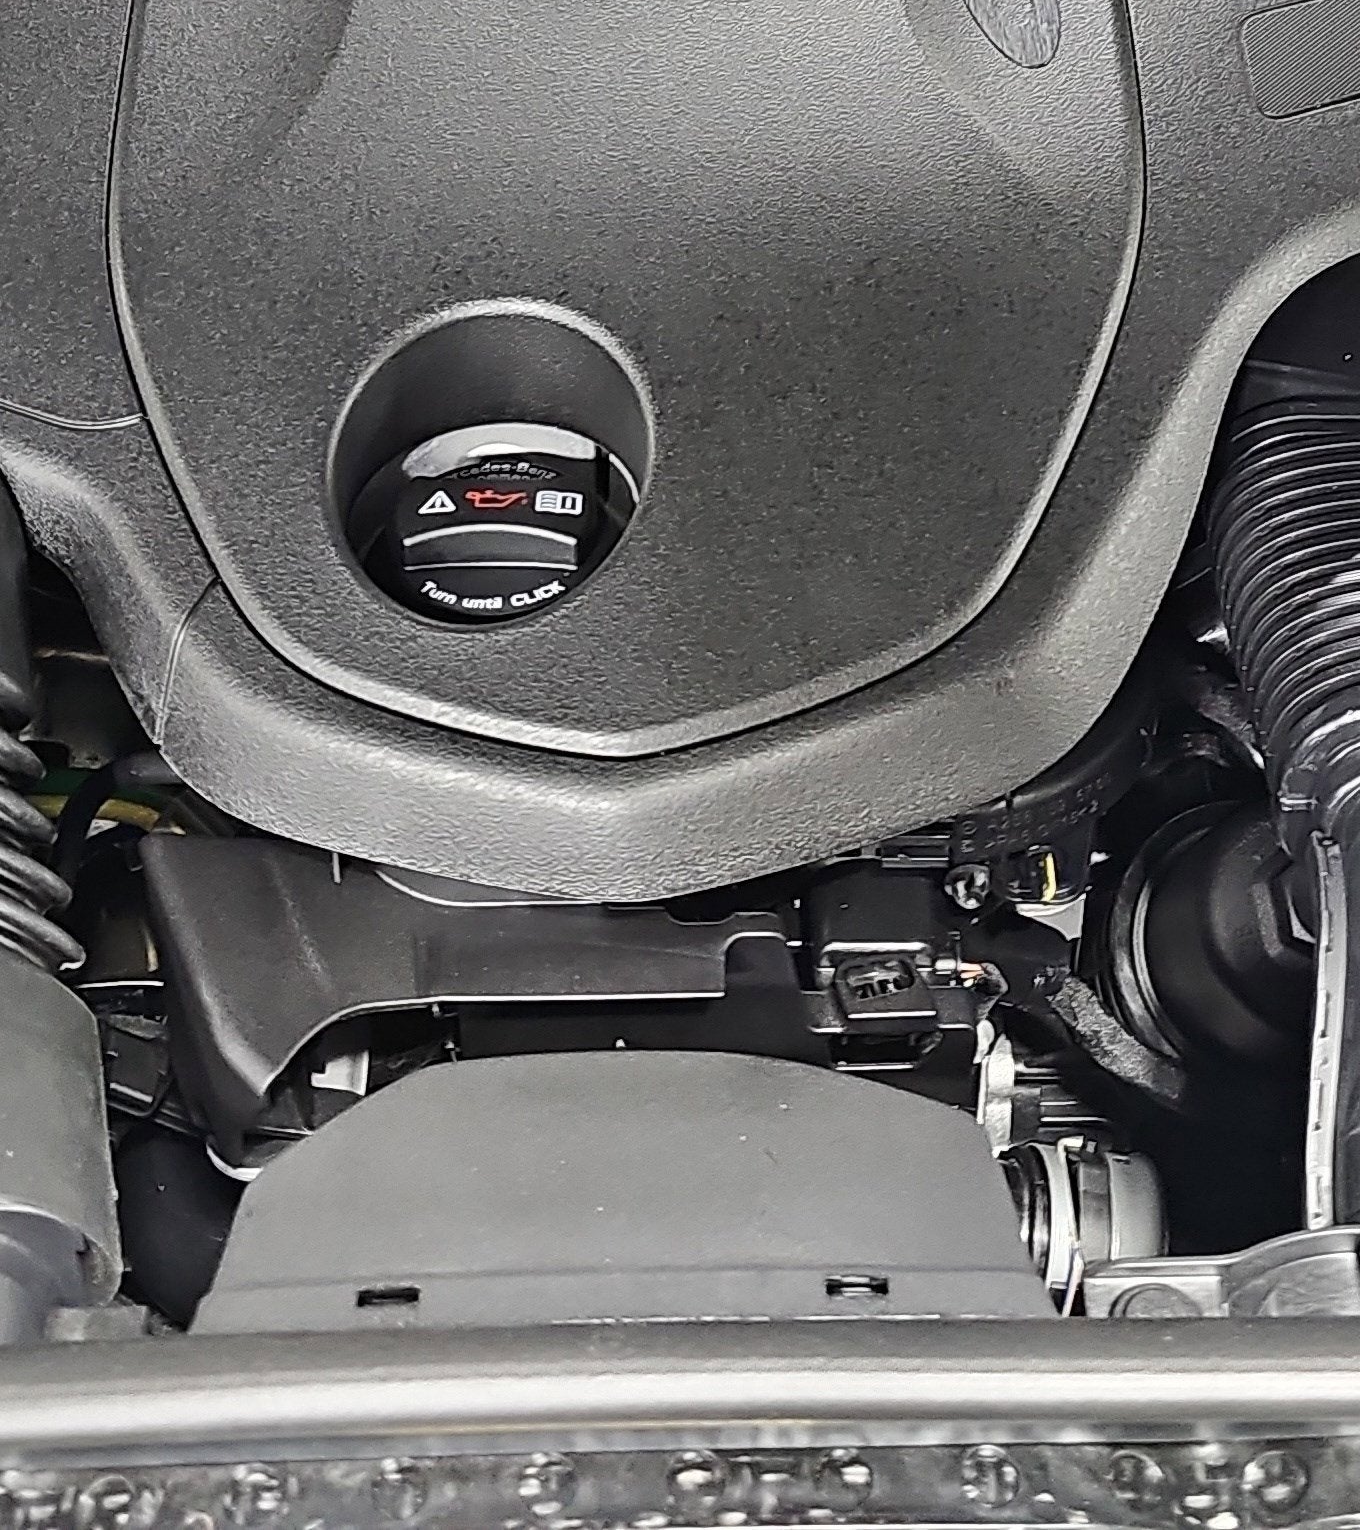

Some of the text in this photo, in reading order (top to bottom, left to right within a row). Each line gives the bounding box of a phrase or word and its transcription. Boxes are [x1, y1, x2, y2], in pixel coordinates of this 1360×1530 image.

[446, 461, 558, 480] rcedes-Benz
[420, 580, 566, 610] Turn until CLICK
